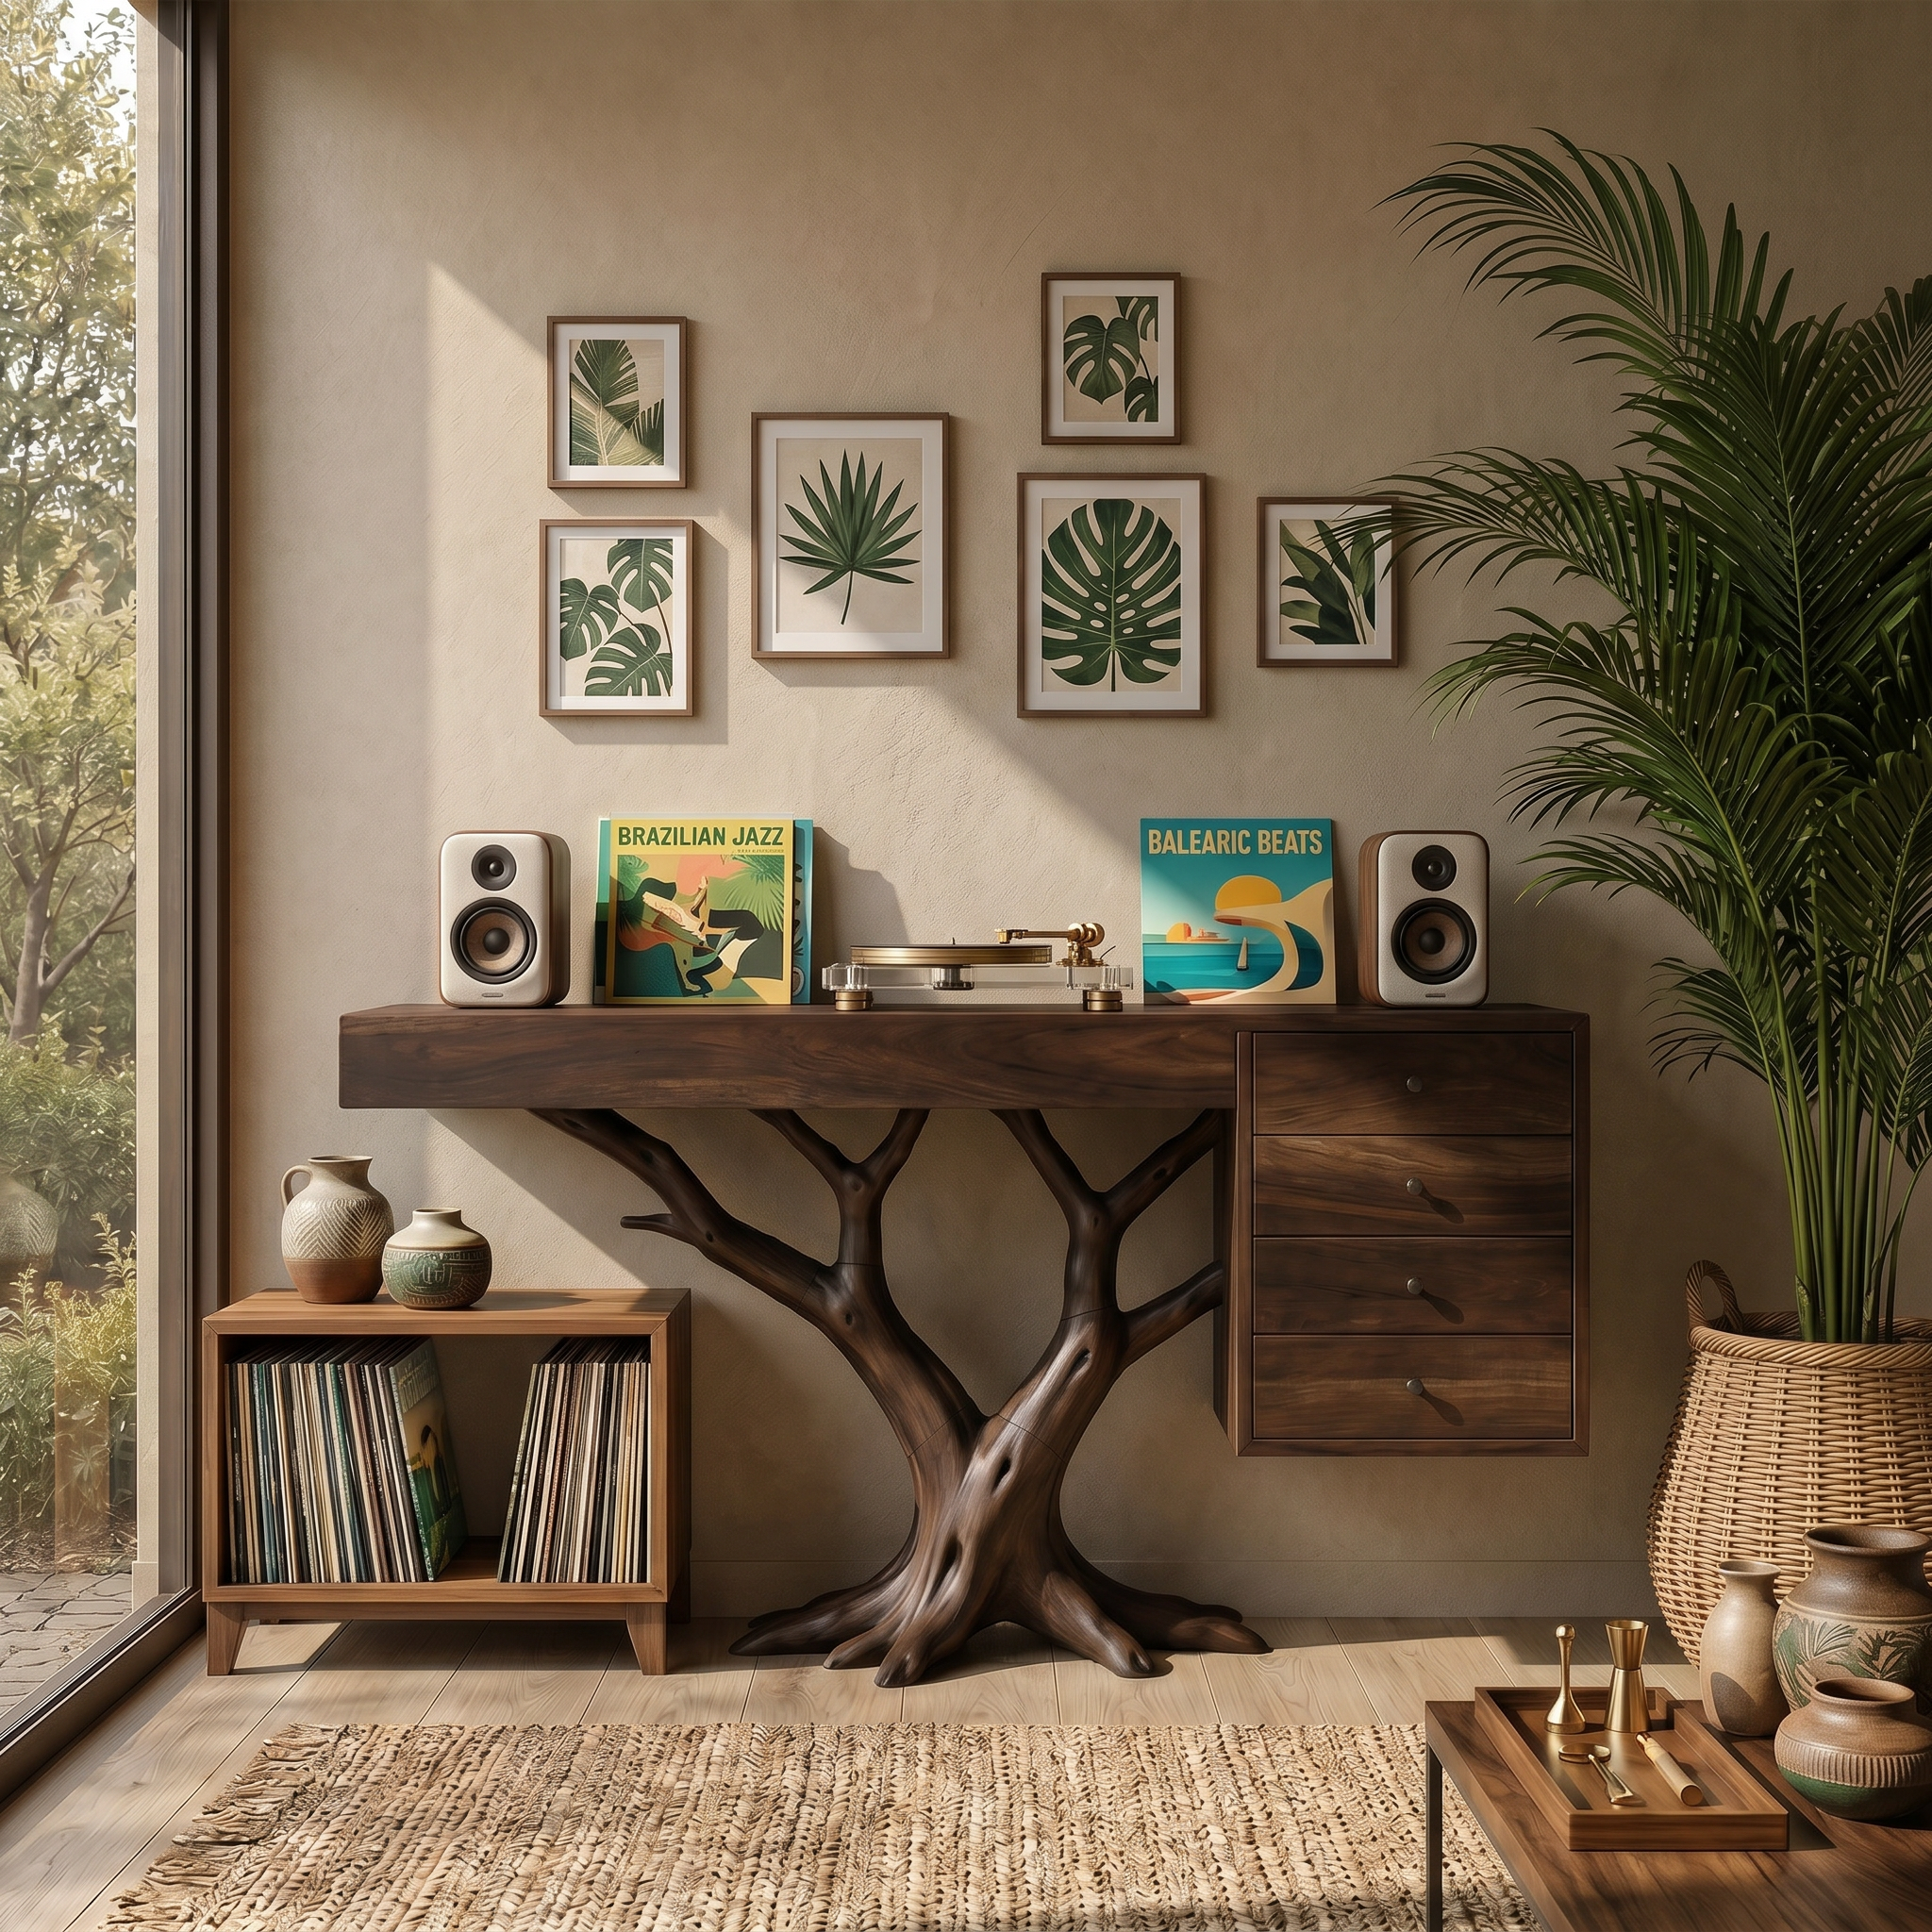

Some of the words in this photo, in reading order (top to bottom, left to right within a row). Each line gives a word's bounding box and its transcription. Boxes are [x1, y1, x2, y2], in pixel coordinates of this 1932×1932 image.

[618, 826, 725, 845] BRAZILIAN
[732, 826, 784, 845] JAZZ
[1148, 829, 1251, 855] BALEARIC
[1257, 829, 1323, 855] BEATS
